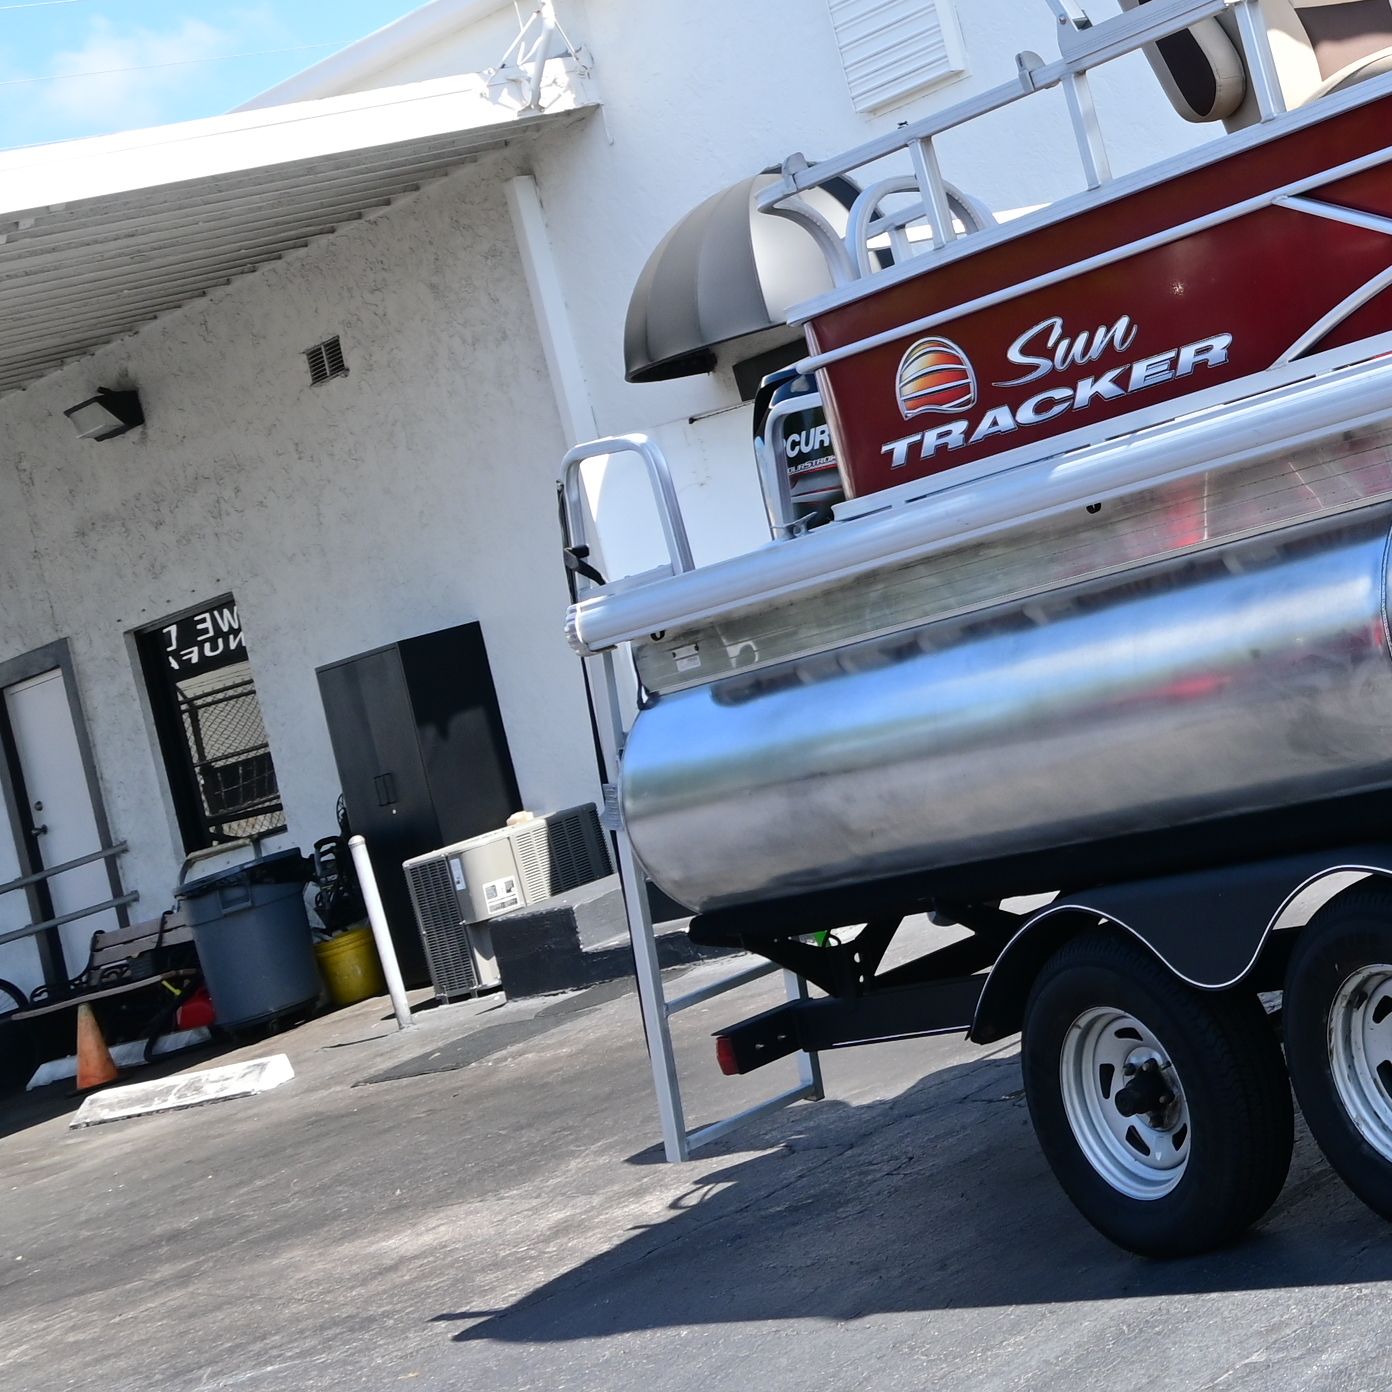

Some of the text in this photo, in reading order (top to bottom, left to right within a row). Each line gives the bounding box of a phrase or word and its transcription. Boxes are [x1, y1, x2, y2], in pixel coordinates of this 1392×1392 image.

[992, 314, 1138, 387] Sun
[880, 332, 1233, 470] TRACKER
[782, 424, 831, 458] CUR
